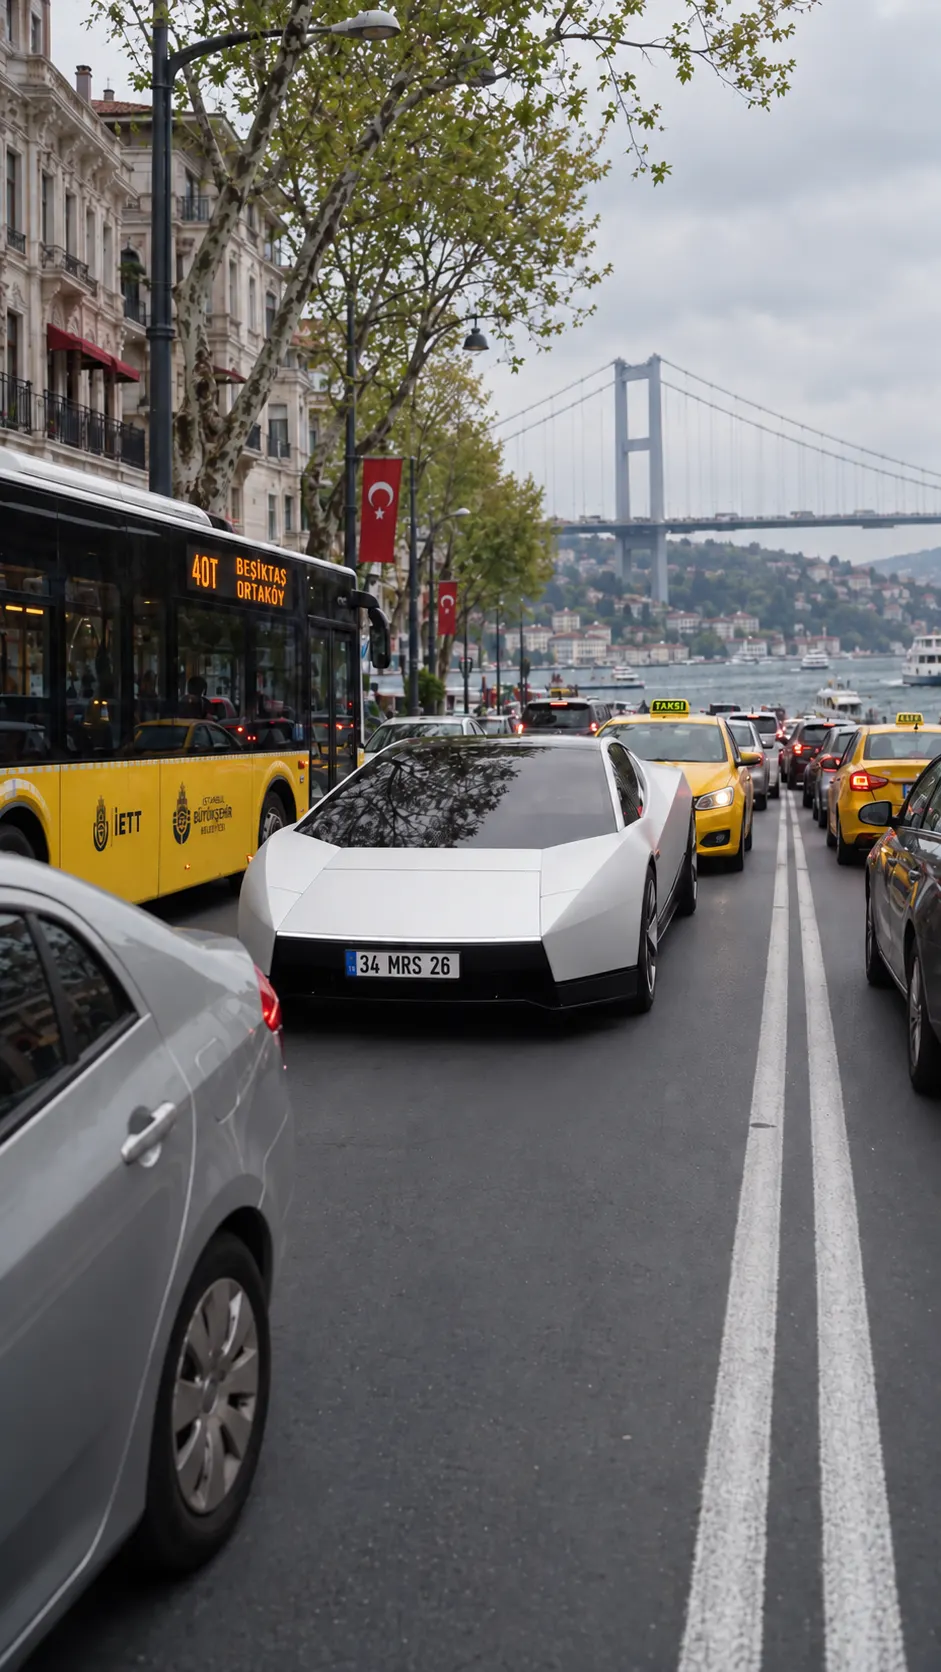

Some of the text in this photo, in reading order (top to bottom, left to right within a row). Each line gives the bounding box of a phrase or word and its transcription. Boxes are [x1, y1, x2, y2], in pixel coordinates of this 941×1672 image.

[192, 554, 218, 589] 40T
[236, 557, 287, 587] BEŞİKTAŞ
[115, 806, 142, 836] İETT
[360, 955, 450, 975] 34 MRS 26
